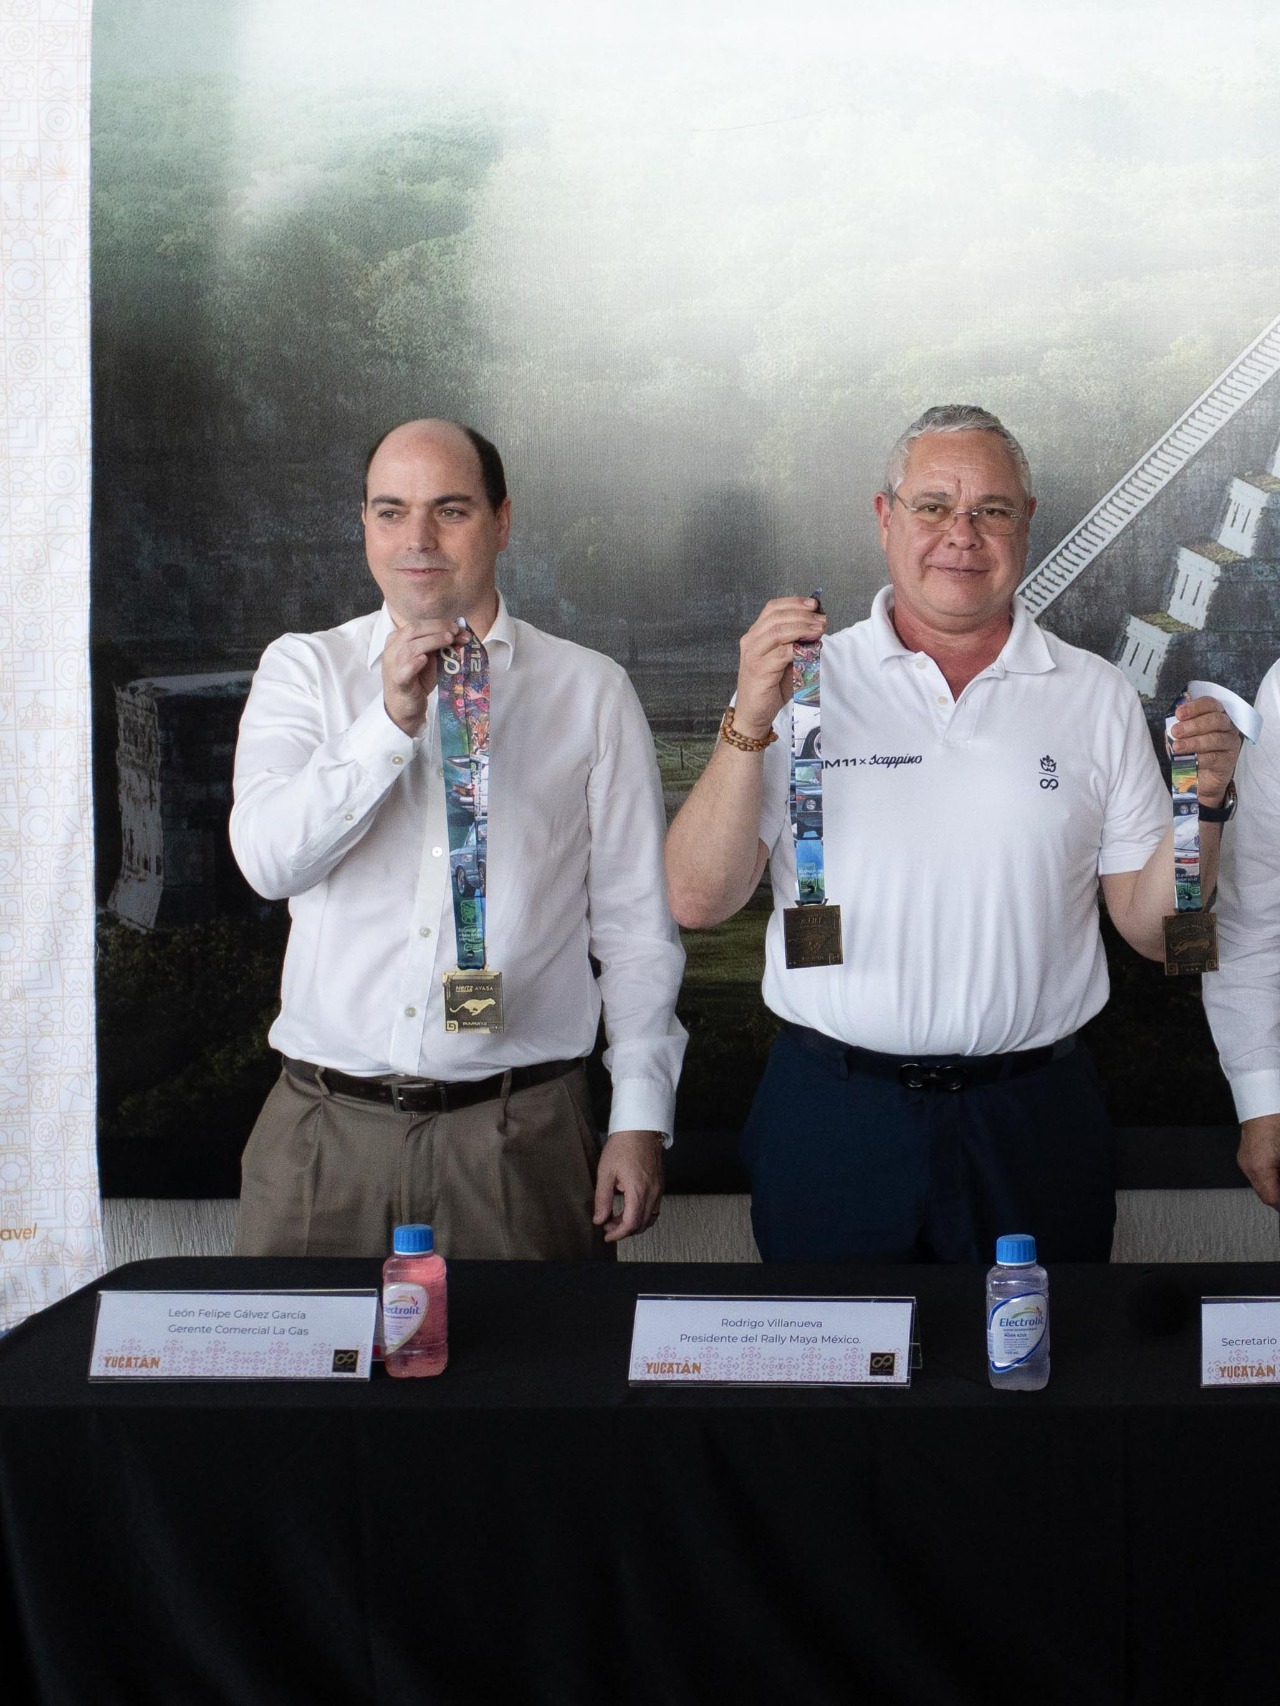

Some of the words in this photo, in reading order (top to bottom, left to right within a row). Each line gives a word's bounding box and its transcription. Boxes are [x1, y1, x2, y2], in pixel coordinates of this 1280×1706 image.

[869, 753, 923, 769] Scappino
[168, 1308, 196, 1318] León
[198, 1308, 232, 1320] Felipe
[233, 1309, 270, 1320] Gálvez
[271, 1310, 307, 1320] García
[167, 1323, 213, 1334] Gerente
[214, 1324, 271, 1335] Comercial
[272, 1326, 286, 1336] La
[287, 1326, 310, 1336] Gas
[721, 1318, 765, 1330] Rodrigo
[766, 1318, 823, 1328] Villanueva
[679, 1333, 739, 1344] Presidente
[740, 1334, 758, 1343] del
[760, 1333, 787, 1346] Rally
[789, 1334, 818, 1346] Maya
[821, 1334, 862, 1345] México.
[1221, 1335, 1278, 1347] Secretario
